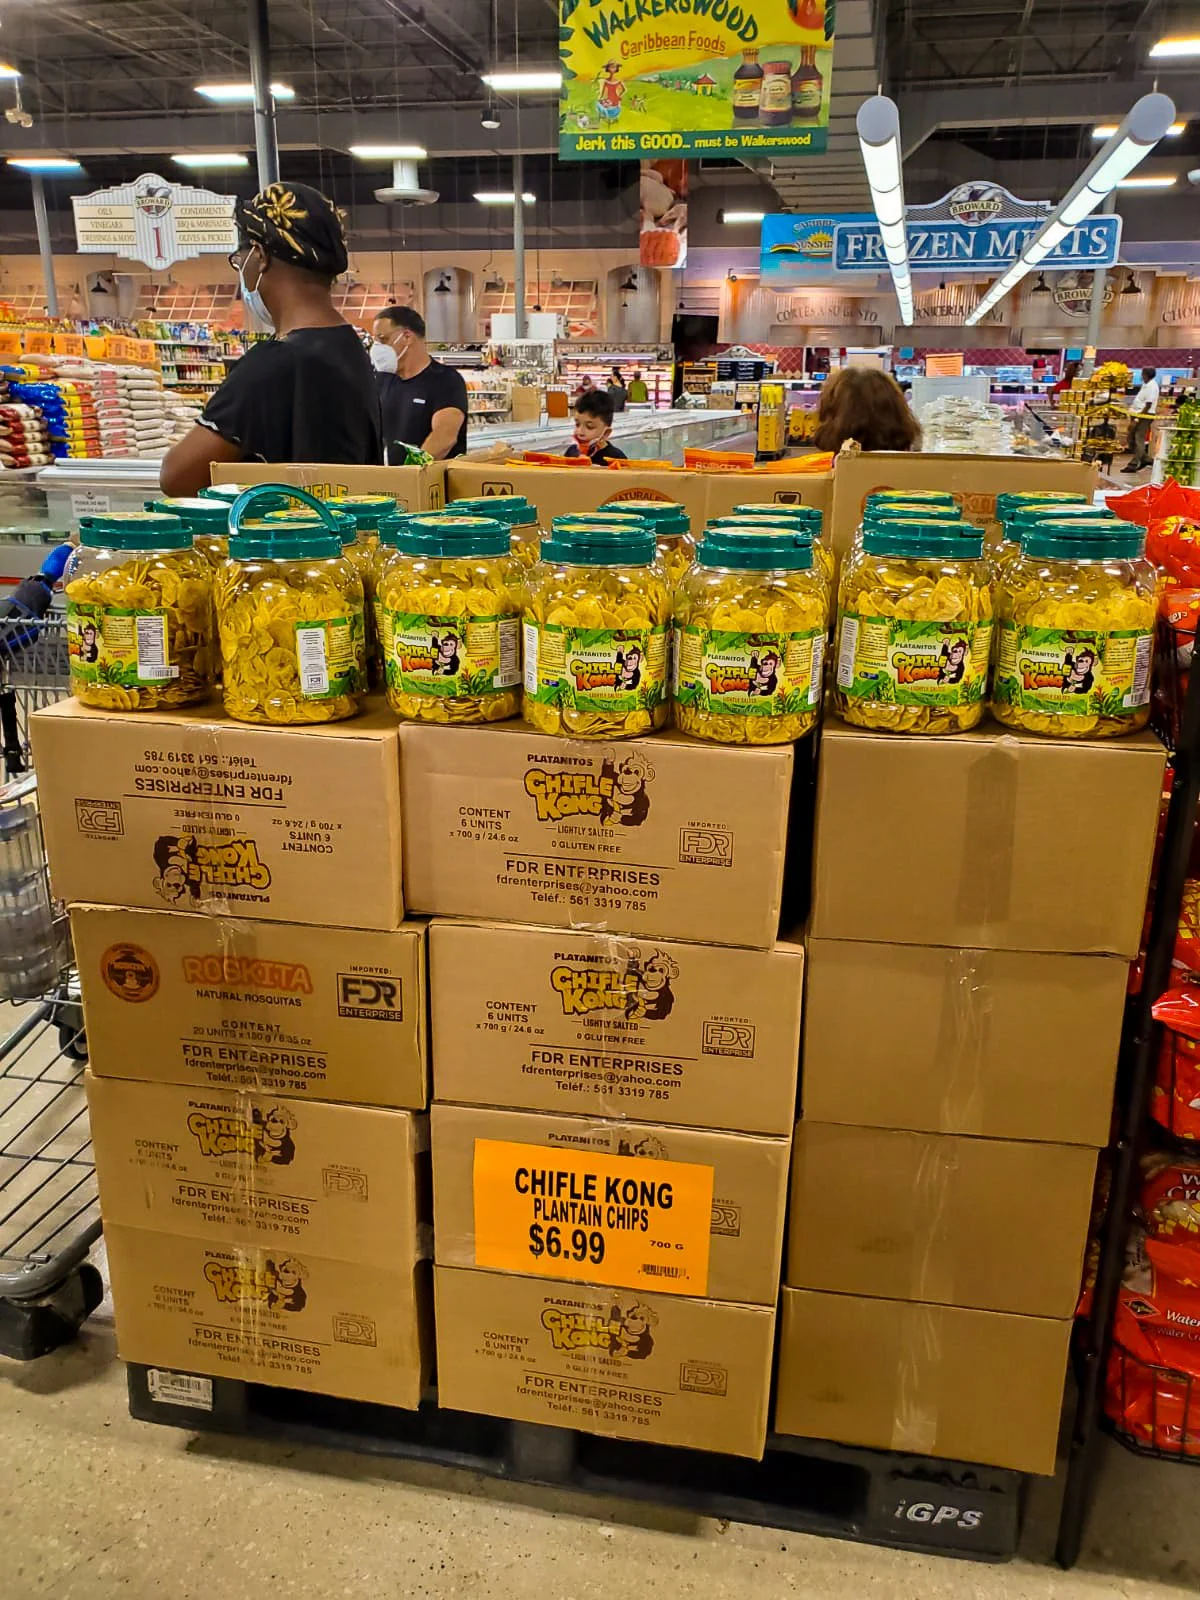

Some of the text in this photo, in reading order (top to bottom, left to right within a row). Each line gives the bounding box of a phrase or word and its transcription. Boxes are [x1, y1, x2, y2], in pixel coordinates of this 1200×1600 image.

[620, 30, 726, 58] Caribbean Foods
[575, 132, 812, 151] Jerk this GOOD... must be Walkerswood
[97, 208, 113, 216] OILS
[180, 207, 226, 215] CONDIMENTS
[951, 202, 1000, 215] BROWARD
[90, 221, 124, 229] VINEGARS
[178, 234, 199, 242] OLIVES
[207, 233, 232, 242] PICKLES
[846, 231, 977, 260] FRZEN
[1056, 289, 1112, 301] BROWD
[396, 641, 439, 659] CHIFLE
[570, 659, 623, 675] CHIFLE
[892, 652, 948, 668] CHIFLE
[1019, 658, 1072, 676] CHIFLE
[705, 663, 757, 680] CHIFLE
[144, 750, 219, 765] 561 3319 785
[527, 753, 593, 767] PLATANITOS
[134, 764, 293, 786] fdrenterprises@yahoo.com
[134, 777, 283, 801] FDR ENTERPRISES
[524, 768, 614, 799] CHIFLE
[173, 809, 196, 819] FREE
[458, 806, 511, 820] CONTENT
[535, 792, 603, 822] KONG
[80, 809, 121, 833] FDR
[318, 823, 335, 831] 700
[461, 819, 502, 831] 6 UNITS
[288, 831, 331, 842] 6 UNITS
[456, 830, 473, 840] 700
[475, 832, 481, 841] g
[507, 835, 520, 843] oz
[557, 825, 615, 839] LIGHTLY SALTED
[281, 842, 334, 854] CONTENT
[559, 841, 622, 854] GLUTEN FREE
[683, 830, 730, 857] FDR
[196, 840, 259, 867] KONG
[680, 854, 733, 867] ENTERPRISE
[187, 862, 272, 890] CHIFLE
[506, 859, 661, 886] FDR ENTERPRISES
[496, 874, 658, 899] fdrenterprises@yahoo.com
[569, 895, 647, 912] 561 3319 785
[181, 955, 314, 995] ROSKITA
[550, 966, 639, 995] CHIFLE
[196, 989, 303, 1008] NATURAL ROSQUITAS
[342, 976, 397, 1009] FDR
[486, 1000, 538, 1013] CONTENT
[562, 988, 628, 1015] KONG
[339, 1006, 402, 1021] ENTERPRISE
[487, 1012, 529, 1024] 6 UNITS
[221, 1019, 281, 1033] CONTENT
[500, 1025, 507, 1033] g
[514, 1025, 532, 1035] 24.6
[534, 1027, 545, 1035] oz
[583, 1018, 639, 1032] LIGHTLY SALTED
[193, 1026, 205, 1036] 20
[206, 1027, 237, 1039] UNITS
[265, 1034, 272, 1043] g
[584, 1033, 646, 1045] GLUTEN FREE
[705, 1023, 752, 1050] FDR
[182, 1044, 328, 1070] FDR ENTERPRISES
[531, 1050, 684, 1077] FDR ENTERPRISES
[521, 1064, 682, 1088] fdrenterprises@yahoo.com
[288, 1080, 308, 1091] 785
[594, 1083, 670, 1101] 561 3319 785
[135, 1139, 179, 1152] CONTENT
[548, 1133, 610, 1147] PLATANITOS
[178, 1185, 207, 1199] FDR
[514, 1167, 674, 1210] CHIFLE KONG
[533, 1197, 649, 1232] PLANTAIN CHIPS
[529, 1222, 606, 1265] $6.99
[650, 1240, 684, 1251] 700 G
[541, 1309, 622, 1336] CHIFLE
[195, 1327, 222, 1340] FDR
[483, 1331, 529, 1345] CONTENT
[551, 1326, 611, 1350] KONG
[493, 1342, 522, 1353] UNITS
[525, 1375, 662, 1407] FDR ENTERPRISES
[894, 1499, 984, 1530] iGPS
